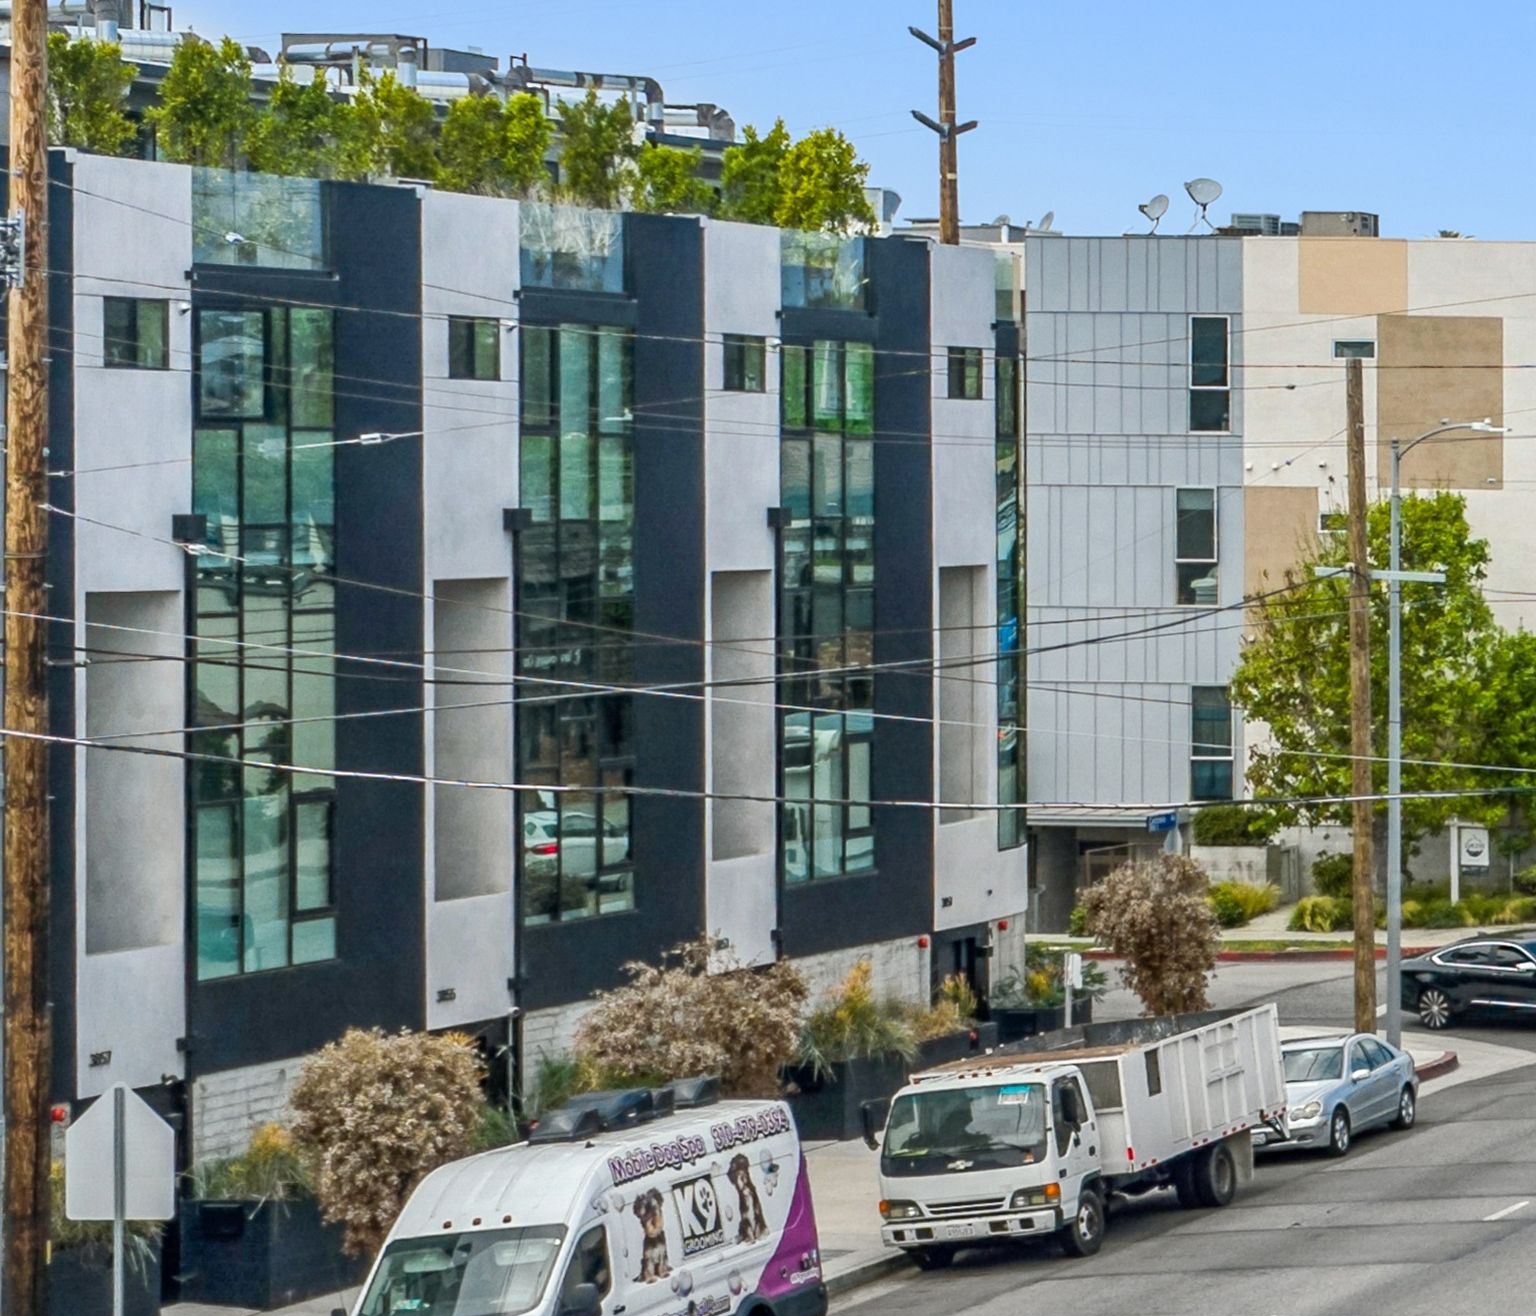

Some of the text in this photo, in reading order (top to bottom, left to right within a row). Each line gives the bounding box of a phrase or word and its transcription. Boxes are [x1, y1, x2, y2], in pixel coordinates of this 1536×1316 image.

[608, 1149, 656, 1185] Mobile
[652, 1140, 683, 1169] Dog
[677, 1134, 706, 1164] Spa
